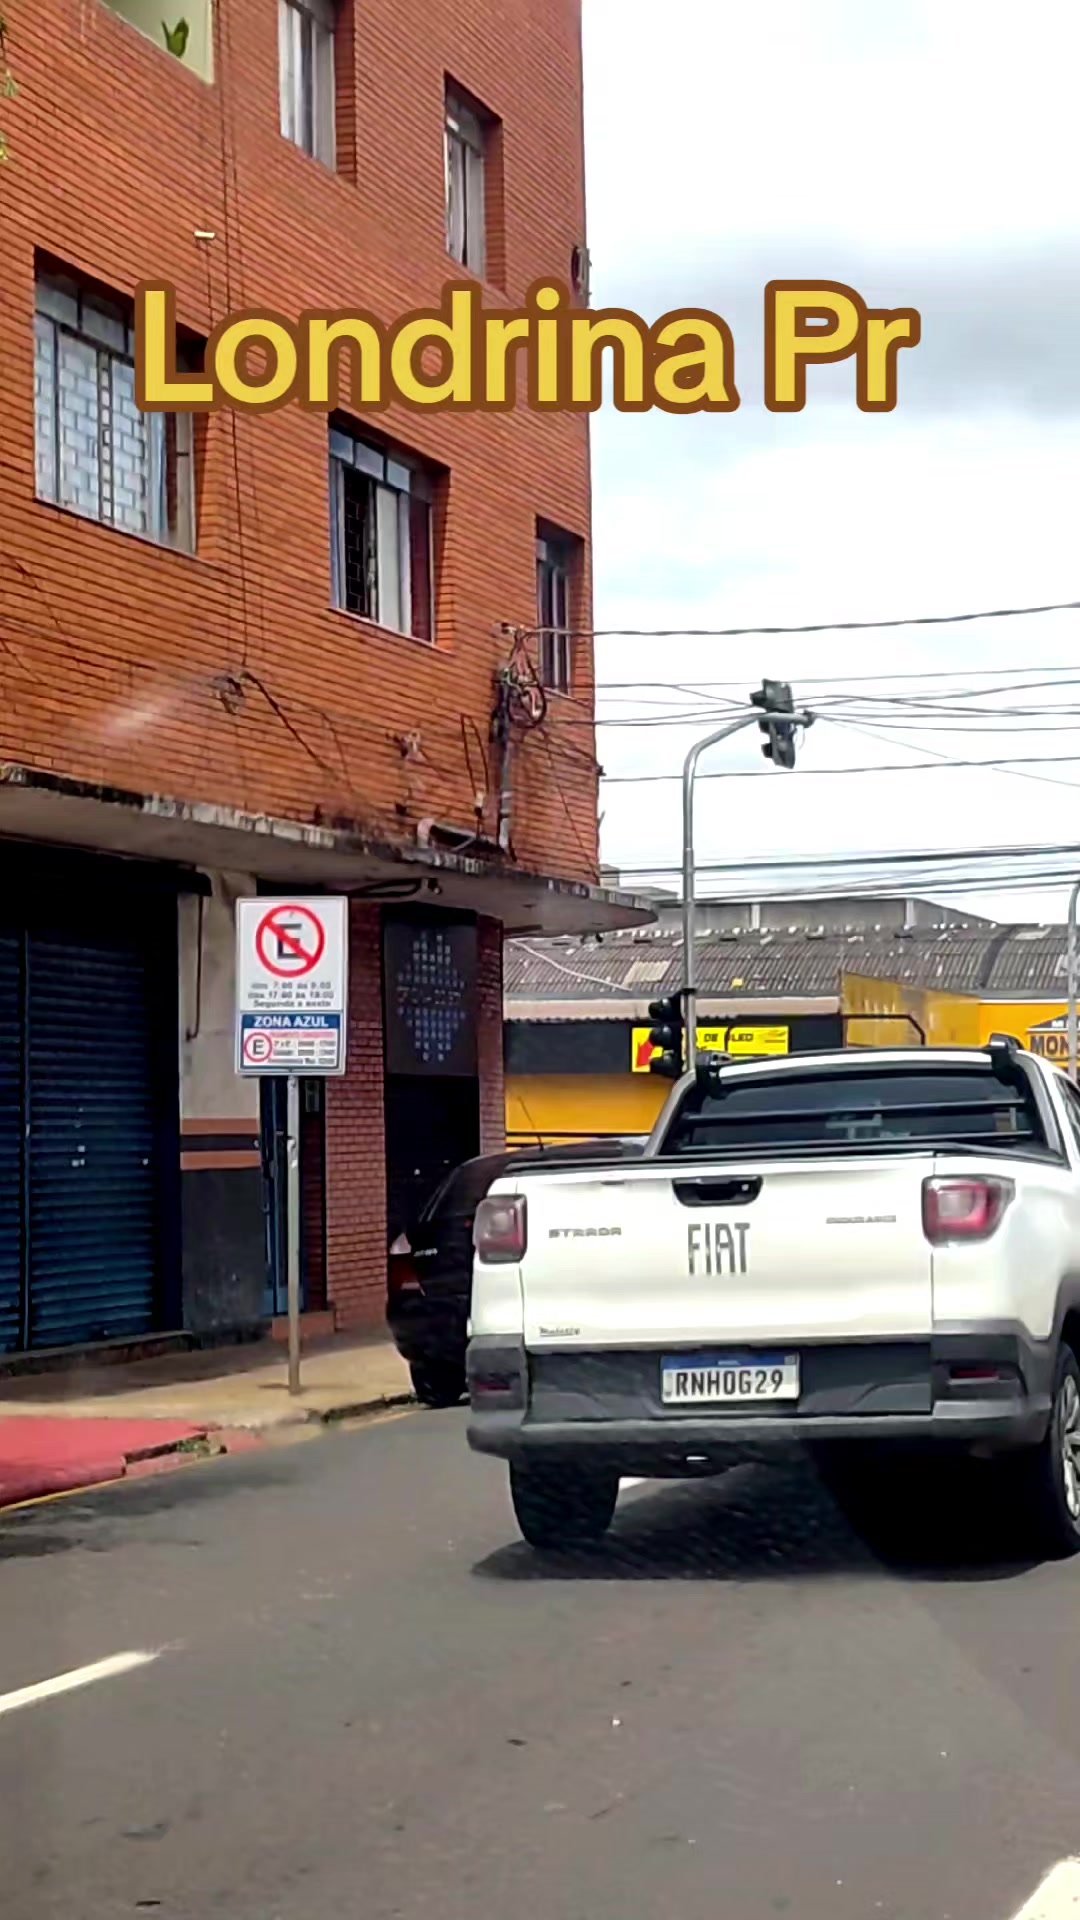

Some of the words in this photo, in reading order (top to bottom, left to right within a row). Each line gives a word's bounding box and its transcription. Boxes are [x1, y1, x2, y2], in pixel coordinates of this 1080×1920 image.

[254, 1015, 291, 1027] ZONA
[293, 1015, 329, 1027] AZUL
[253, 1039, 265, 1055] E
[548, 1227, 622, 1238] STRADA
[688, 1222, 750, 1275] FIAT
